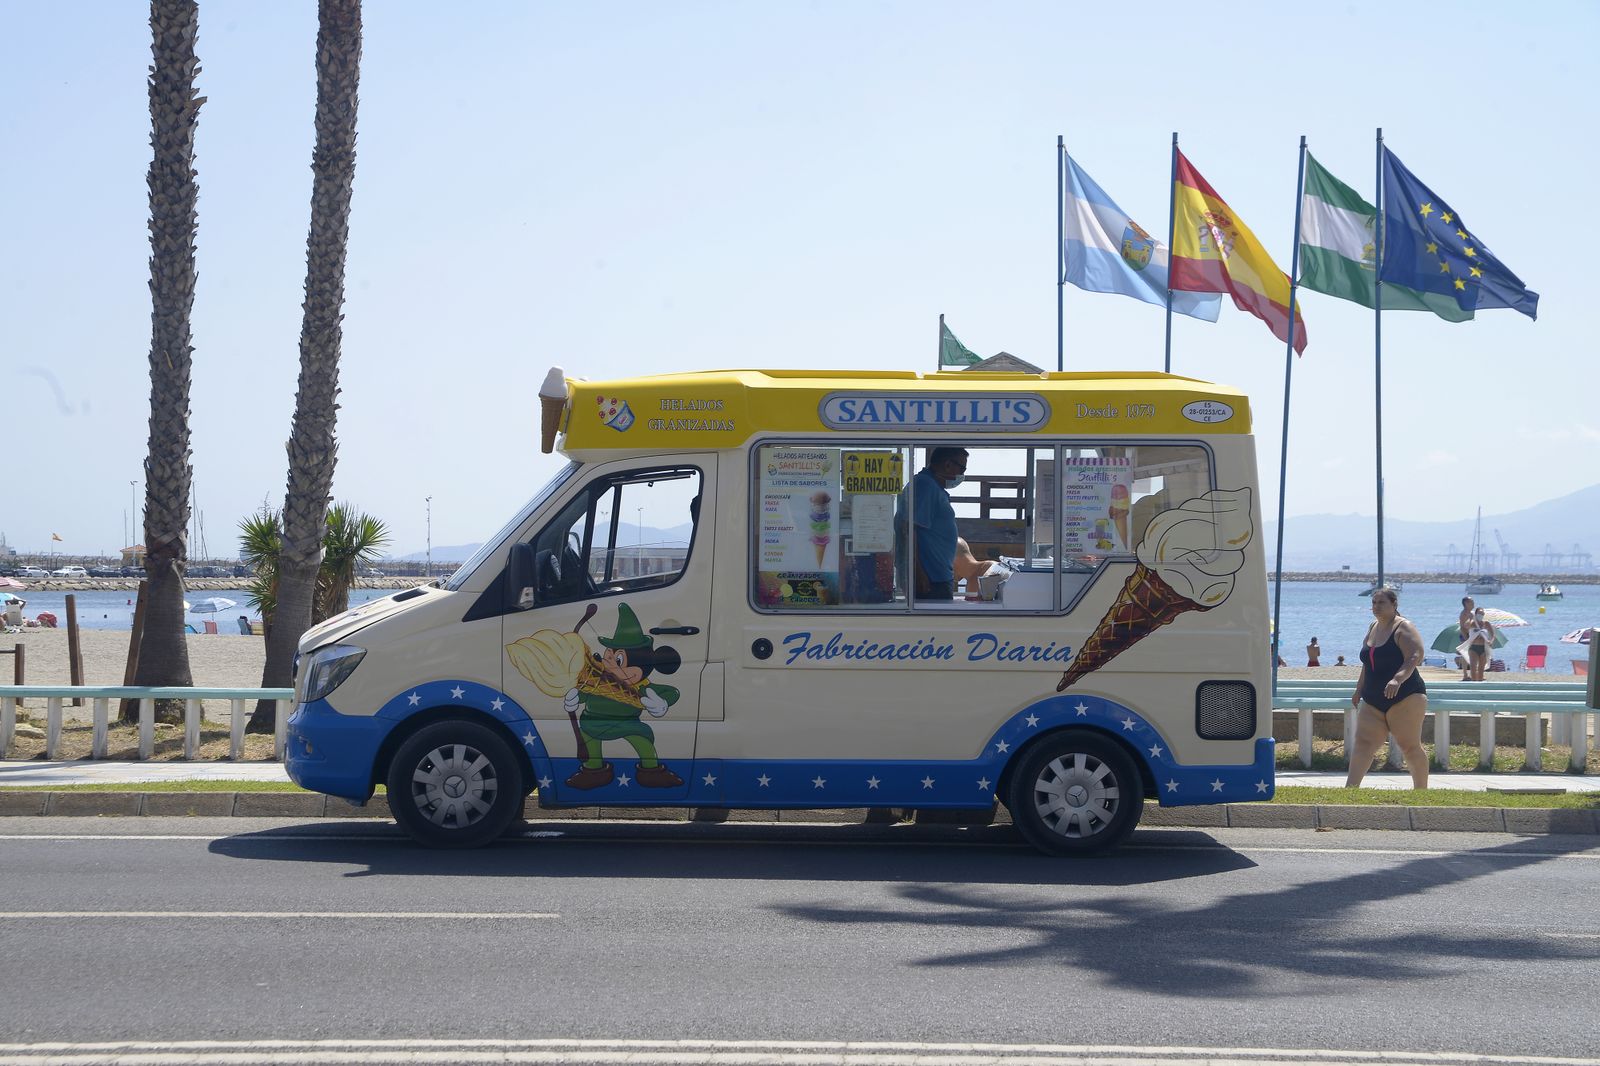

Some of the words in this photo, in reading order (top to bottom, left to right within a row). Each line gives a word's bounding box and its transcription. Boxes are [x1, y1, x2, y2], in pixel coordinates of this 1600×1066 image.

[660, 399, 725, 411] HELADOS
[838, 400, 1031, 424] SANTILLI'S
[1076, 403, 1119, 418] Desde
[1126, 403, 1156, 418] 1979
[648, 419, 735, 431] GRANIZADAS
[773, 452, 797, 460] HELADOS
[864, 458, 884, 474] HAY
[846, 476, 901, 492] GRANIZADA
[782, 632, 956, 666] Fabricación
[966, 632, 1075, 663] Diaria
